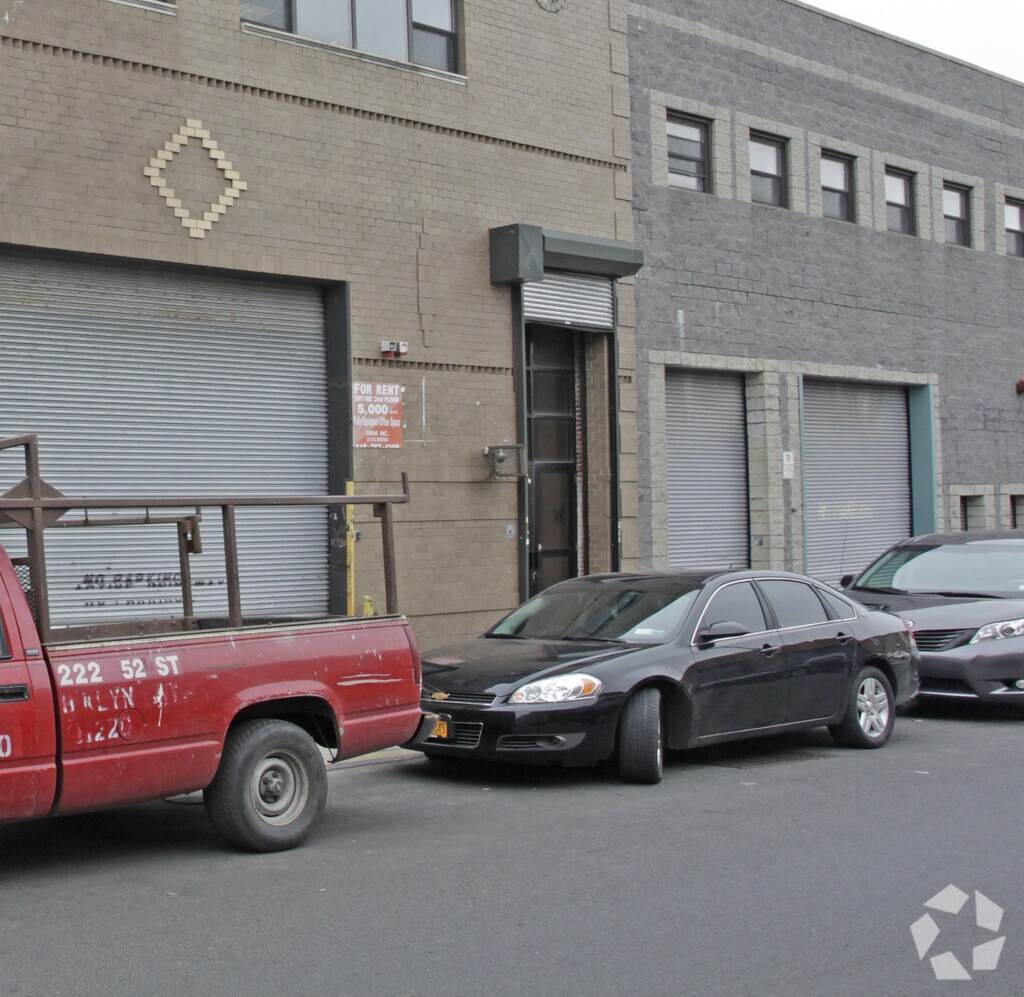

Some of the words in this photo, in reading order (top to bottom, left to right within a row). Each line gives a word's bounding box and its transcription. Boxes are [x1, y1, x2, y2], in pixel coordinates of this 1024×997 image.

[354, 383, 372, 395] FOR
[376, 384, 400, 396] RENT
[357, 403, 388, 415] 5,000
[57, 662, 103, 686] 222
[120, 658, 146, 680] 52
[154, 655, 179, 676] ST
